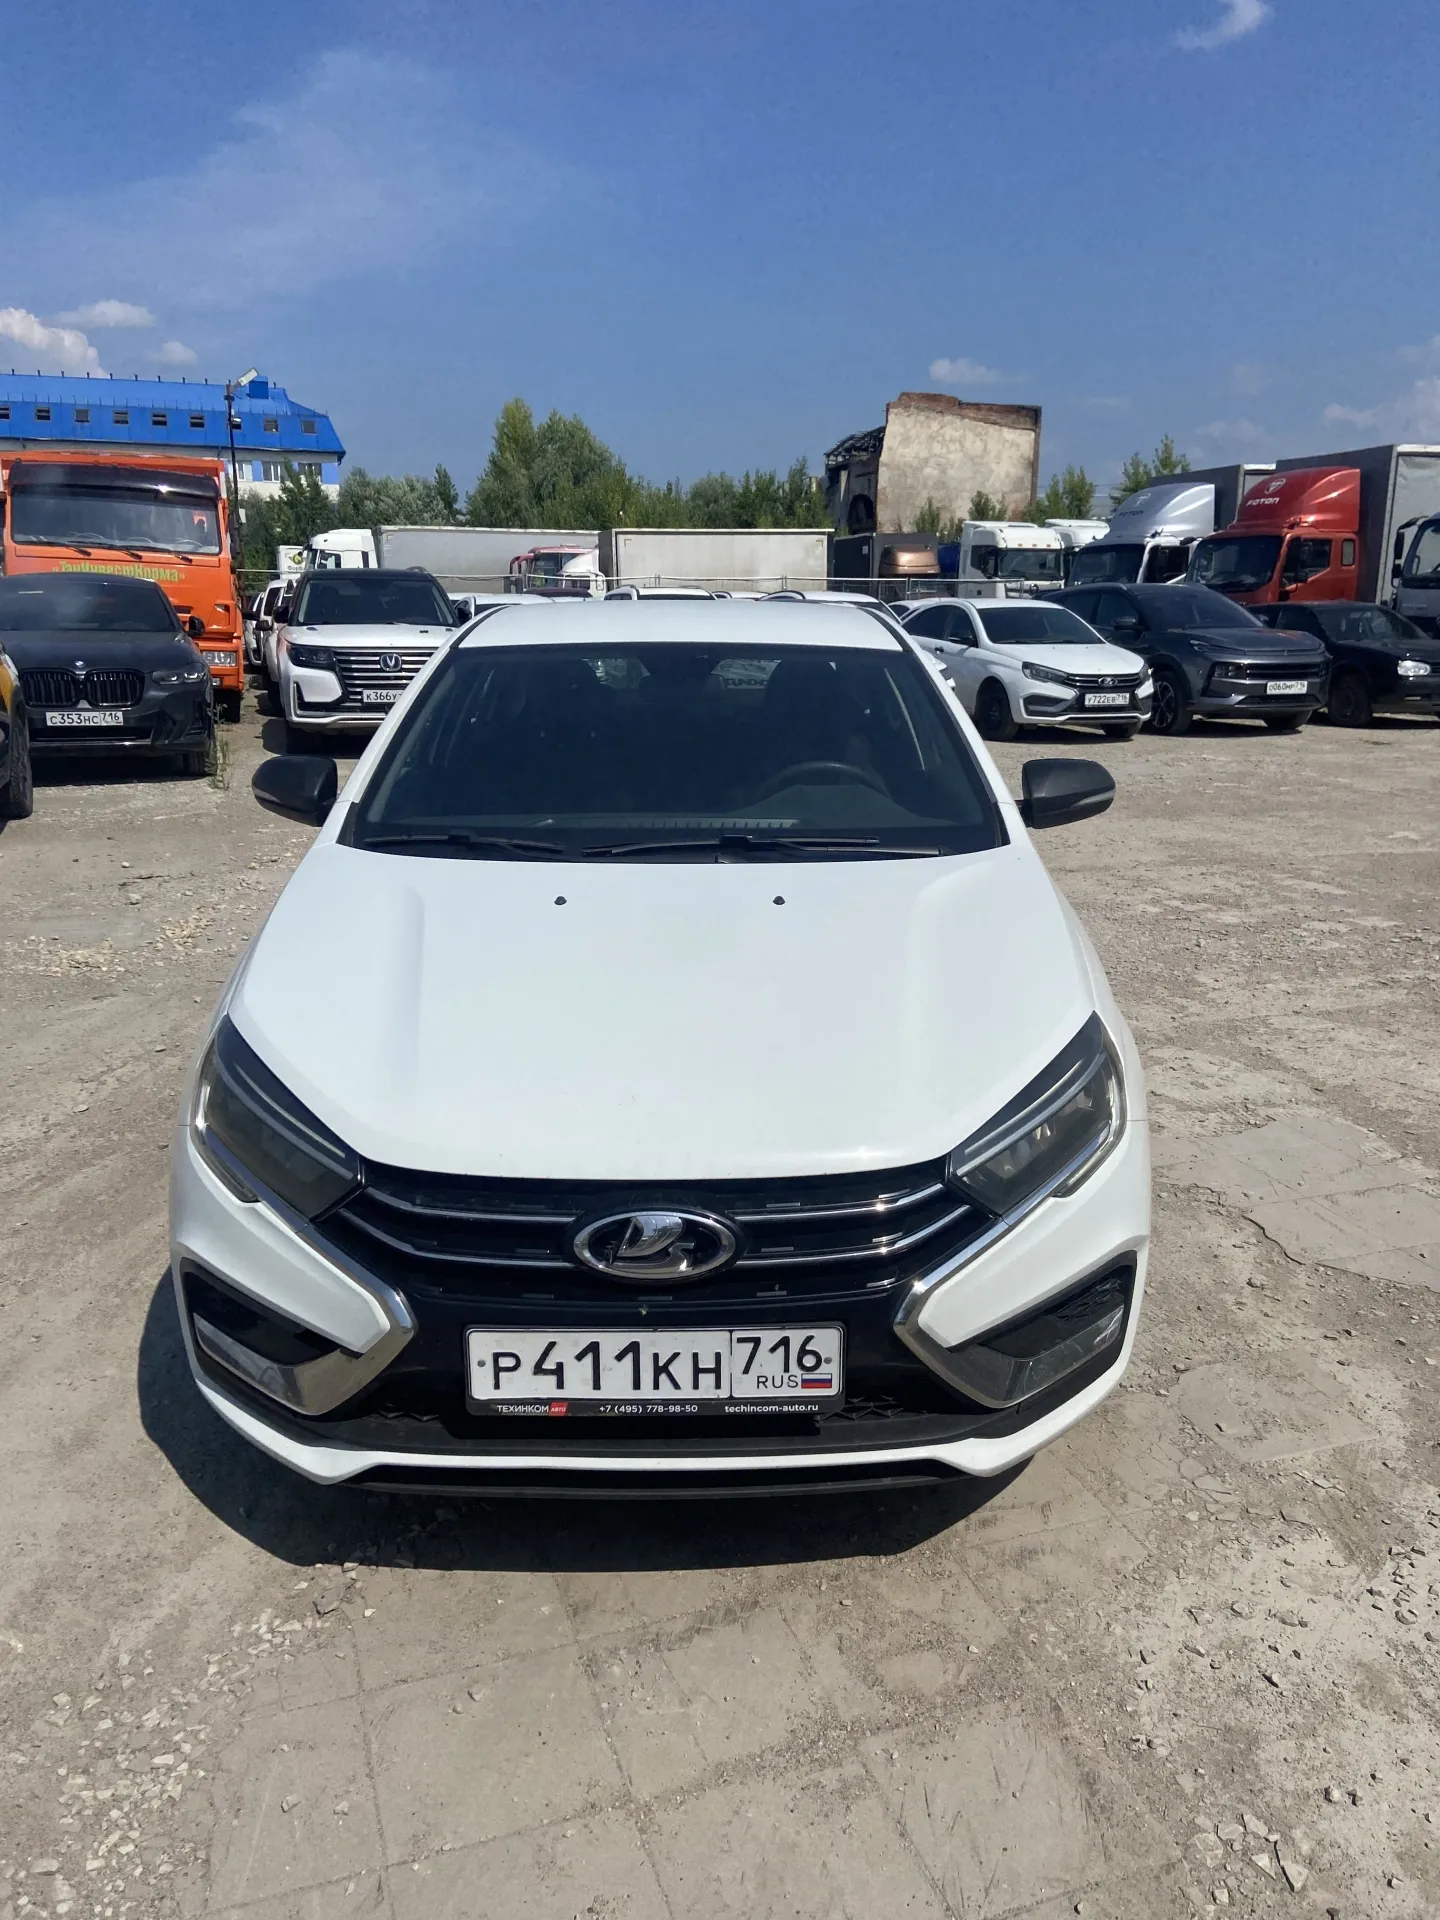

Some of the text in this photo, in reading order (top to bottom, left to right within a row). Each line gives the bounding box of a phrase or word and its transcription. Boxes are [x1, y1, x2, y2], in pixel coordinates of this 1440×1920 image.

[1246, 497, 1280, 507] FOTON
[50, 713, 99, 725] С353НС
[100, 712, 120, 721] 716
[492, 1334, 823, 1391] Р411КН 716
[756, 1374, 799, 1389] RUS
[497, 1404, 549, 1413] ТЕХИНКОМ
[599, 1404, 698, 1414] +7 (495) 778-98-50
[724, 1404, 819, 1413] techincom-auto.ru
